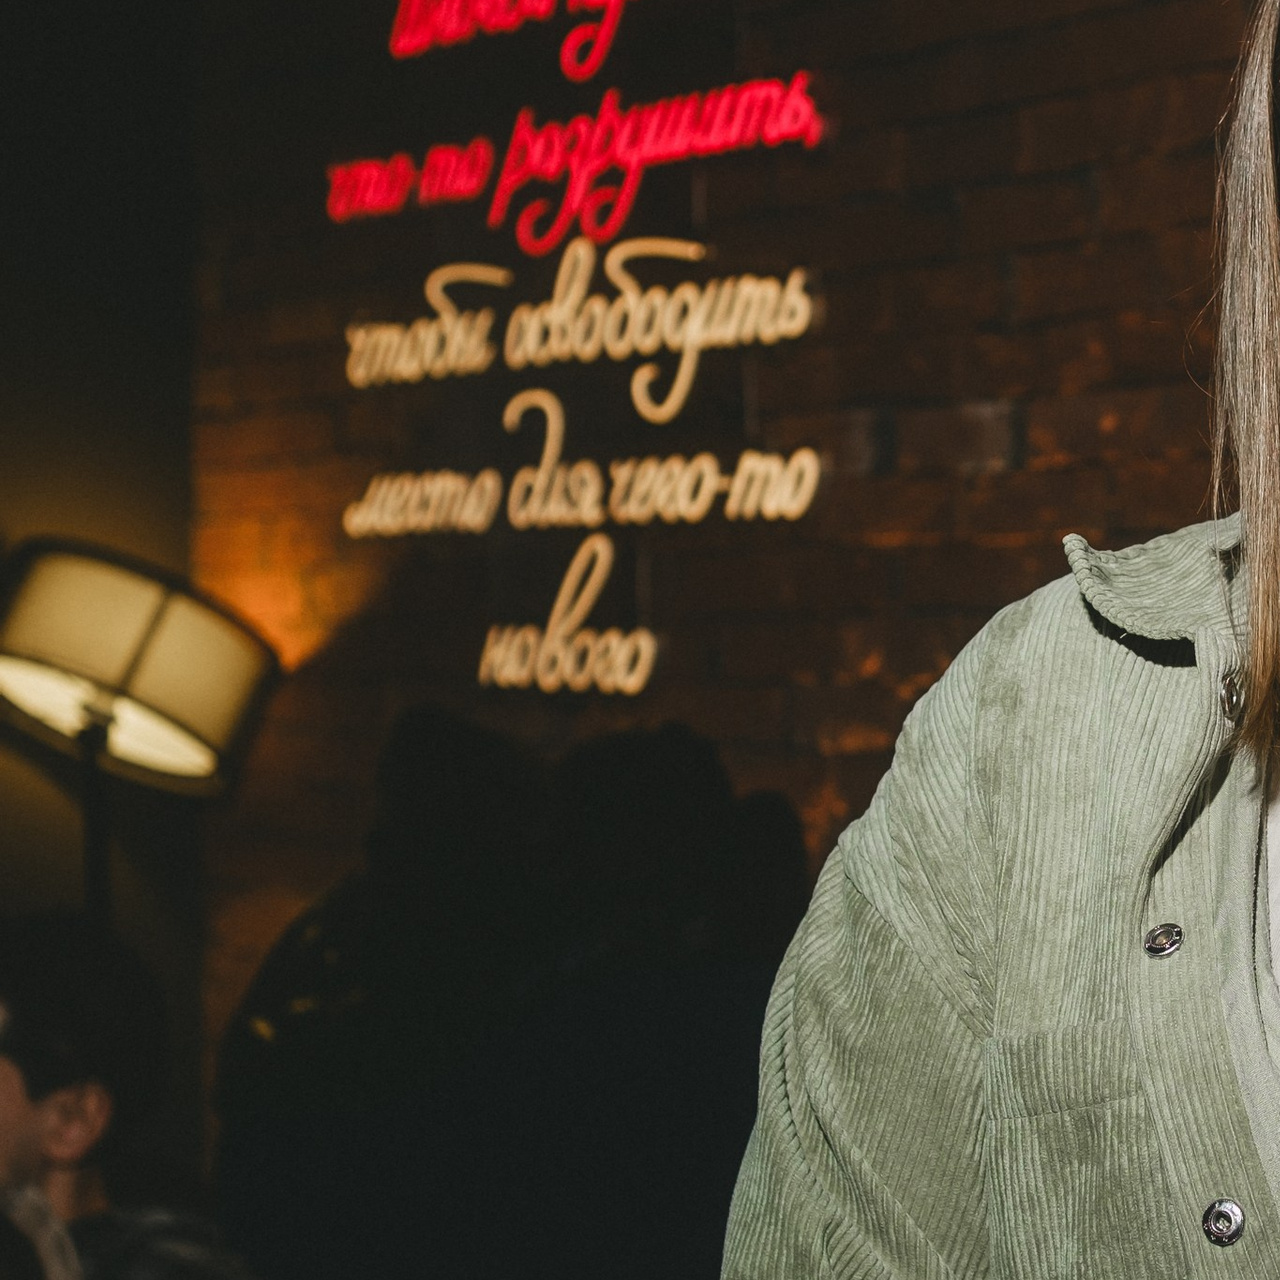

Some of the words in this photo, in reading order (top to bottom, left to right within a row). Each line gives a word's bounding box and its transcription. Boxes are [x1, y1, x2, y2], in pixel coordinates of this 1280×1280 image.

[345, 263, 511, 389] чтобы
[503, 236, 814, 424] освободить
[342, 468, 503, 538] место
[502, 388, 604, 531] для
[608, 447, 822, 526] чего-то
[478, 532, 658, 696] нового
